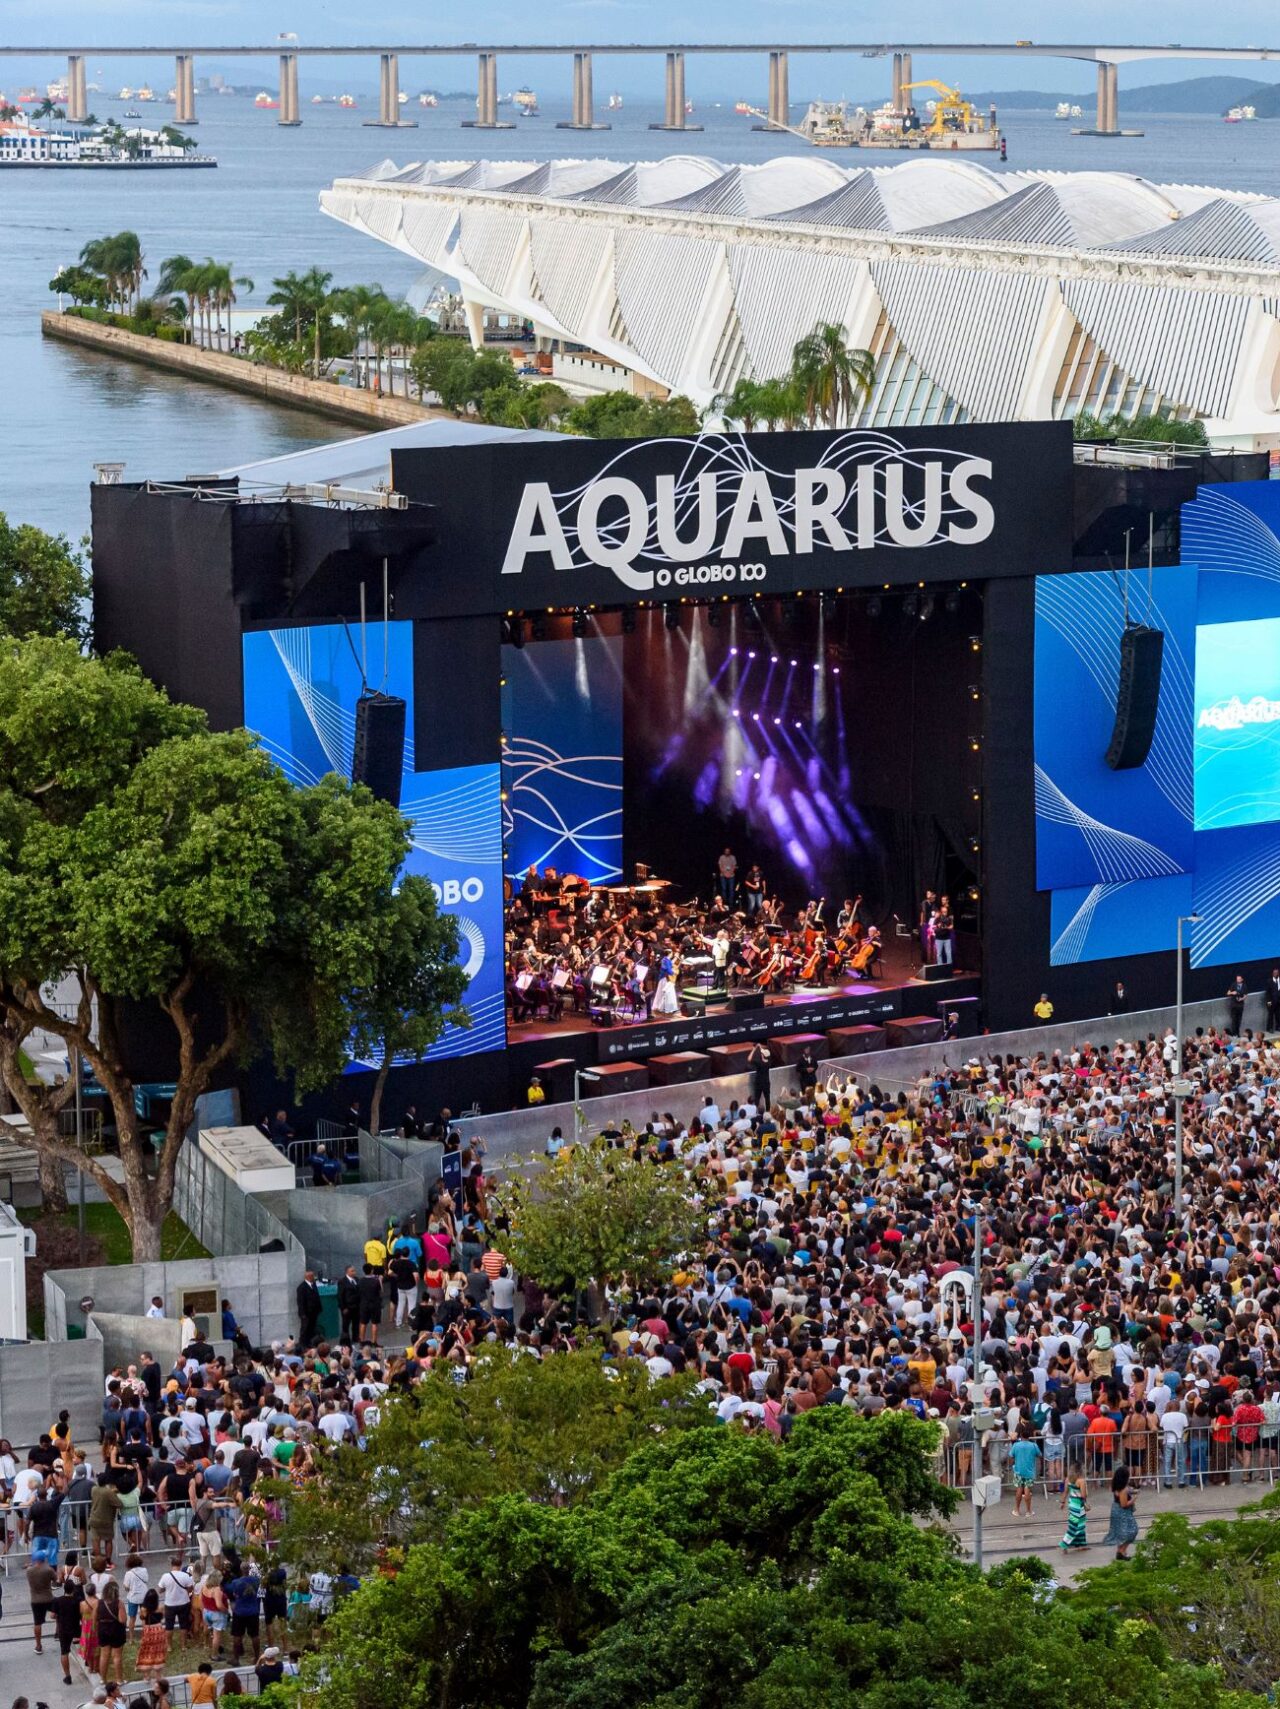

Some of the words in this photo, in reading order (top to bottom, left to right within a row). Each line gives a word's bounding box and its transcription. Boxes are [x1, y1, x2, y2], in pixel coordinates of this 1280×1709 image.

[501, 458, 995, 590] AQUARIUS
[656, 568, 672, 586] O
[674, 564, 736, 585] GLOBO
[739, 563, 767, 581] 100
